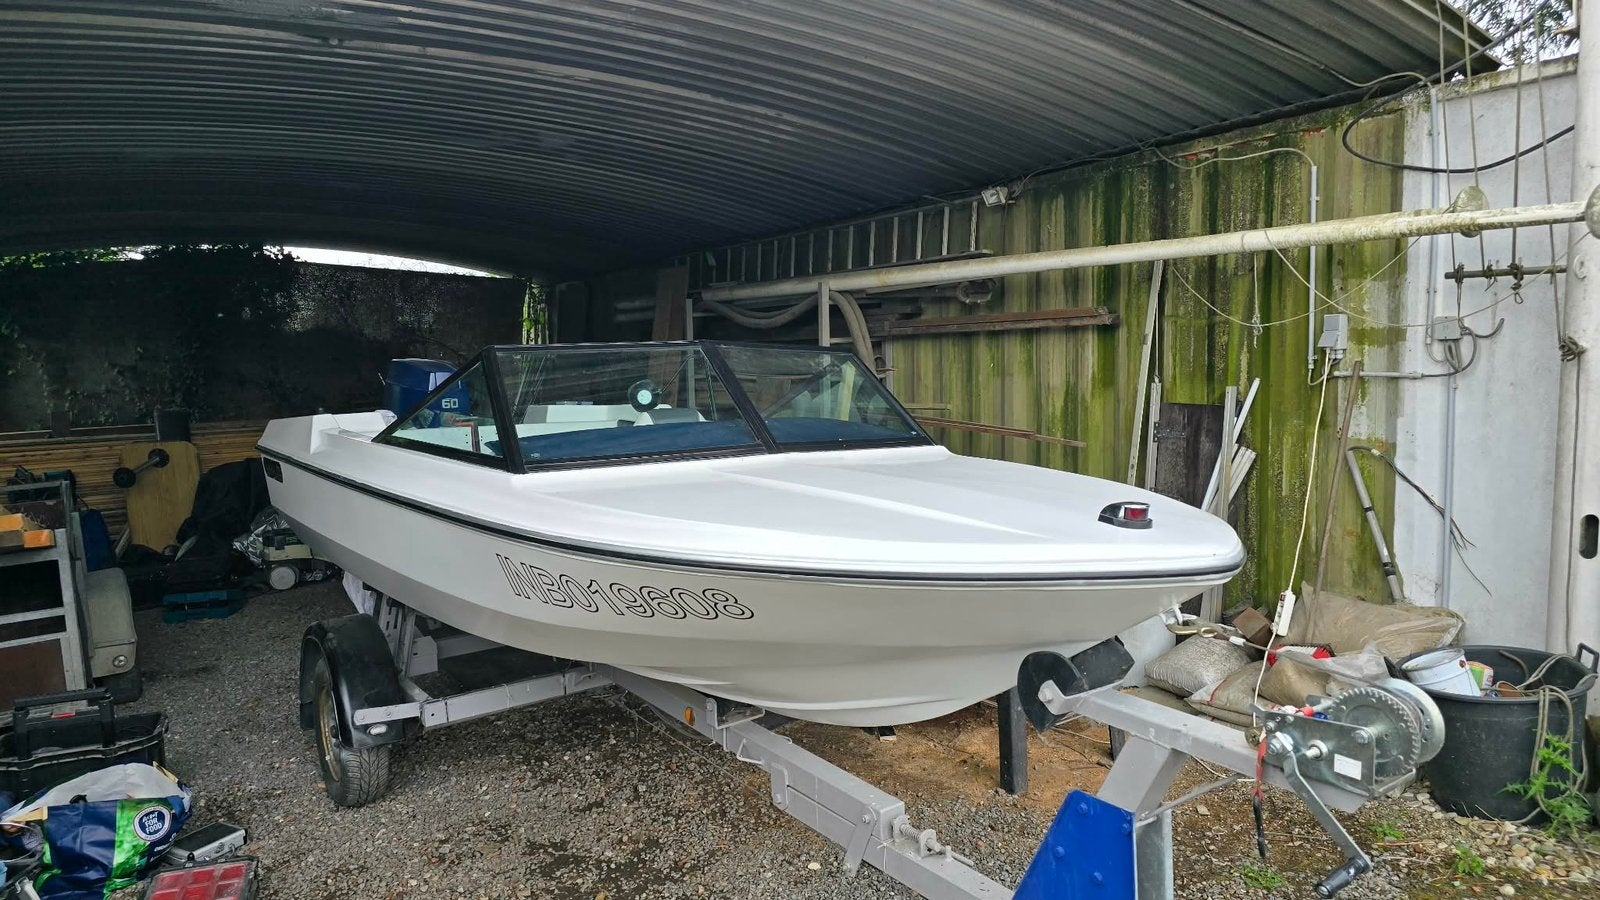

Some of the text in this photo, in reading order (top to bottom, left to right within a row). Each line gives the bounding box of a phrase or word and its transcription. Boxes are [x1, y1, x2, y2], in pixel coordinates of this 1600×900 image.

[441, 397, 459, 409] 60
[496, 553, 755, 620] INB019608
[145, 817, 159, 828] FOR
[145, 822, 163, 834] FOOD
